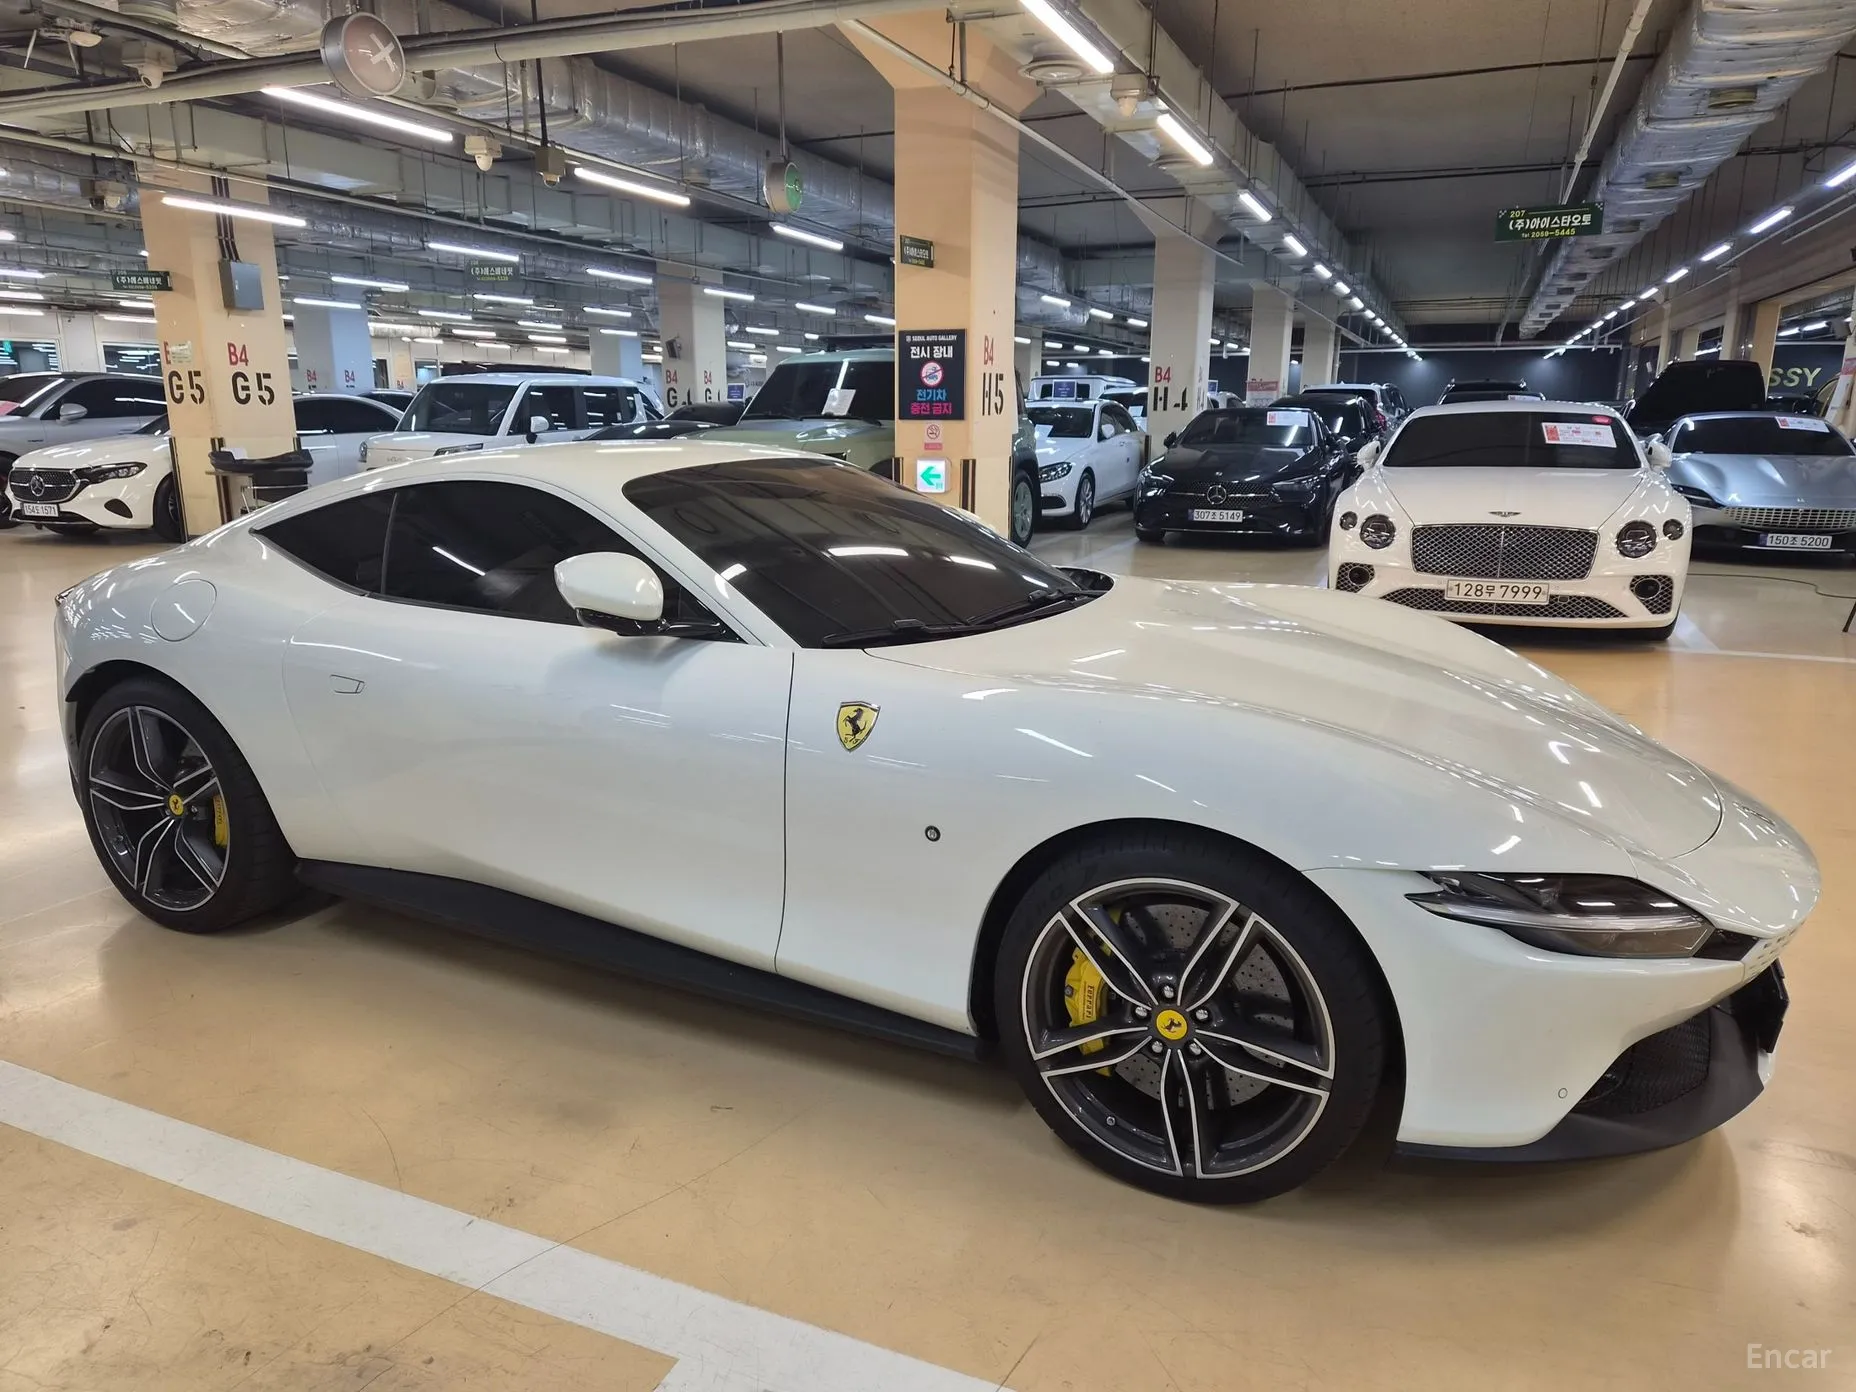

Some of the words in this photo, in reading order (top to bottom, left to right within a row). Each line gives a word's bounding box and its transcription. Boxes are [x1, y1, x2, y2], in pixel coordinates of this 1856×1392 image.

[1508, 213, 1592, 230] (주)아이스타오토
[1510, 210, 1526, 218] 207
[227, 342, 249, 366] B4
[910, 346, 930, 359] 전시
[933, 345, 953, 359] 장내
[983, 334, 995, 366] B4
[306, 369, 318, 383] B4
[344, 369, 356, 383] B4
[665, 369, 678, 384] B4
[703, 370, 713, 384] B4
[1155, 366, 1171, 383] B4
[1769, 367, 1822, 387] SSY
[168, 370, 205, 404] G5
[231, 371, 275, 406] G5
[916, 389, 947, 401] 전기차
[981, 372, 1004, 417] H5
[911, 402, 930, 415] 충전
[932, 402, 952, 415] 금지
[1194, 510, 1217, 520] 307조
[1219, 511, 1241, 521] 5149
[1769, 535, 1798, 546] 150조
[1800, 536, 1829, 547] 5200
[1454, 582, 1496, 598] 128무
[1500, 585, 1543, 600] 7999
[1086, 984, 1095, 1019] Ferrari
